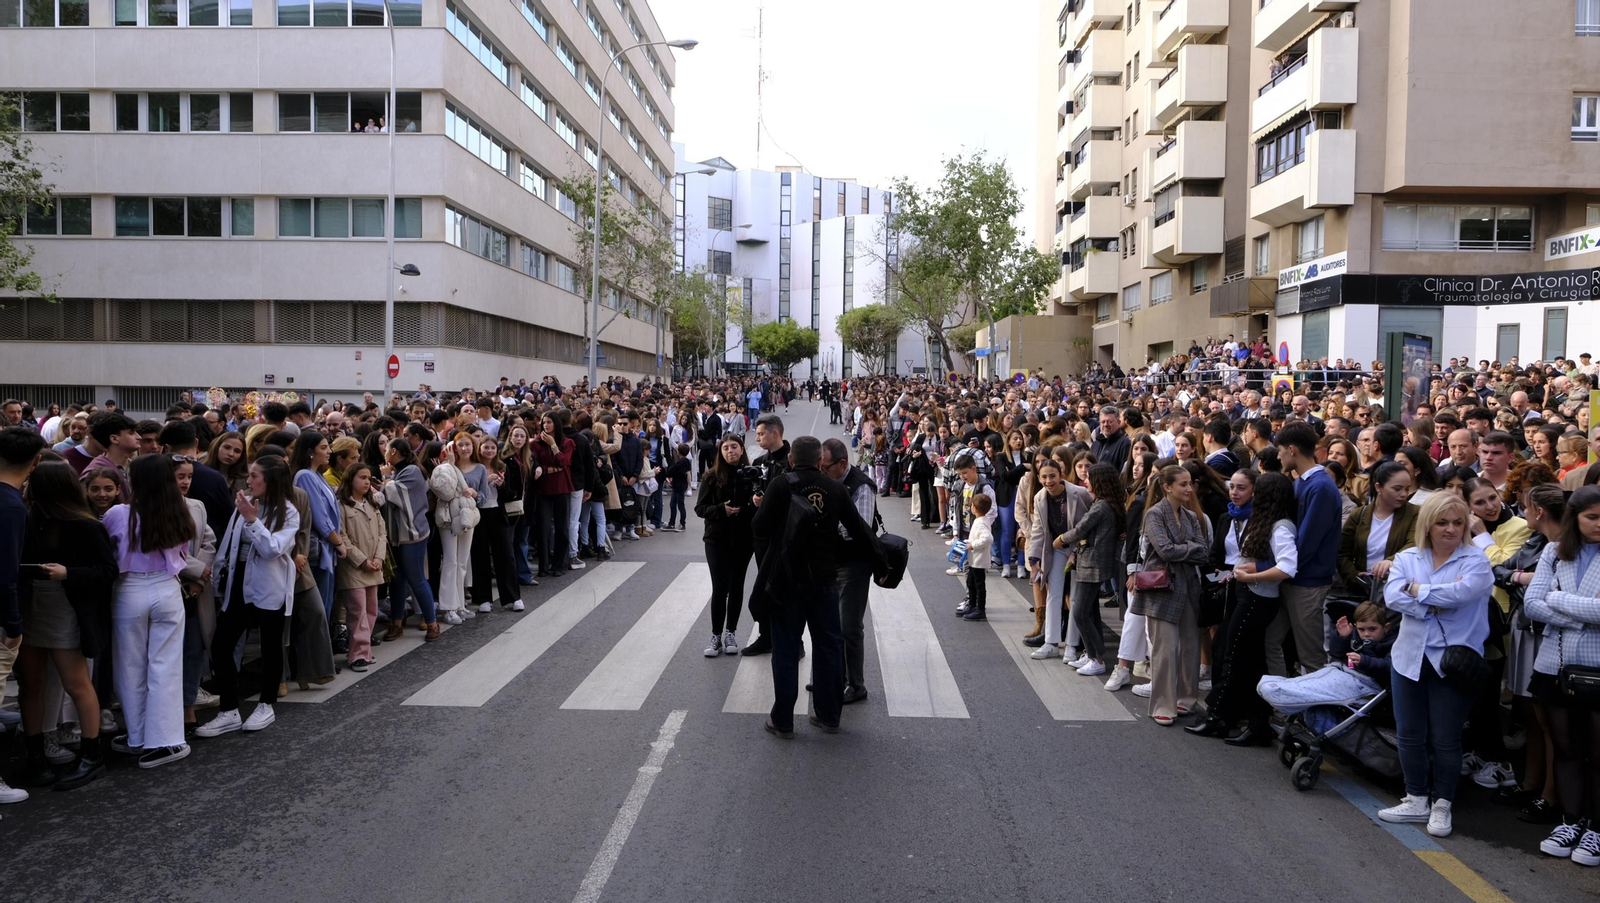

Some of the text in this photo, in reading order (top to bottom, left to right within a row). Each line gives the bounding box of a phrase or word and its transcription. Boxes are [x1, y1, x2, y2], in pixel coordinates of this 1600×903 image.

[1320, 258, 1346, 273] AUDITORES
[1424, 277, 1474, 292] Clínica
[1481, 277, 1505, 292] Dr.
[1511, 272, 1588, 290] Antonio
[1527, 292, 1534, 301] y
